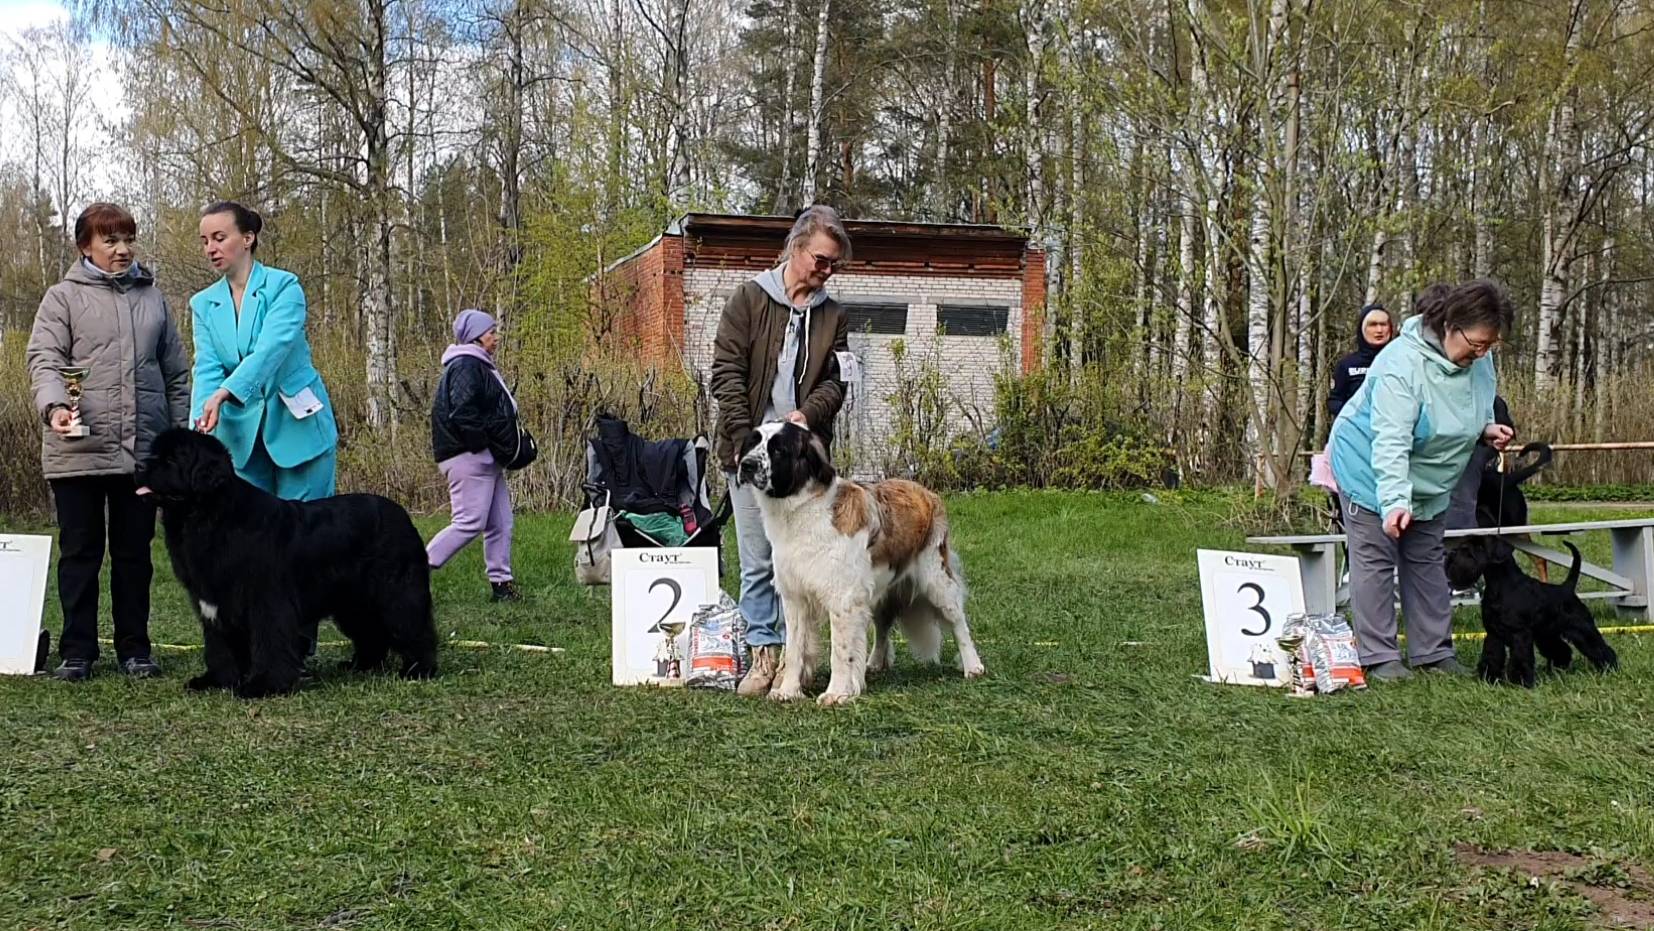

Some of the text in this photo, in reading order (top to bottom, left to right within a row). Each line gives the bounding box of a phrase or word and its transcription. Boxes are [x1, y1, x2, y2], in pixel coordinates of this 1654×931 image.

[639, 552, 681, 564] Стаут
[1224, 555, 1264, 569] Стаут
[647, 577, 682, 634] 2
[1237, 582, 1272, 636] 3
